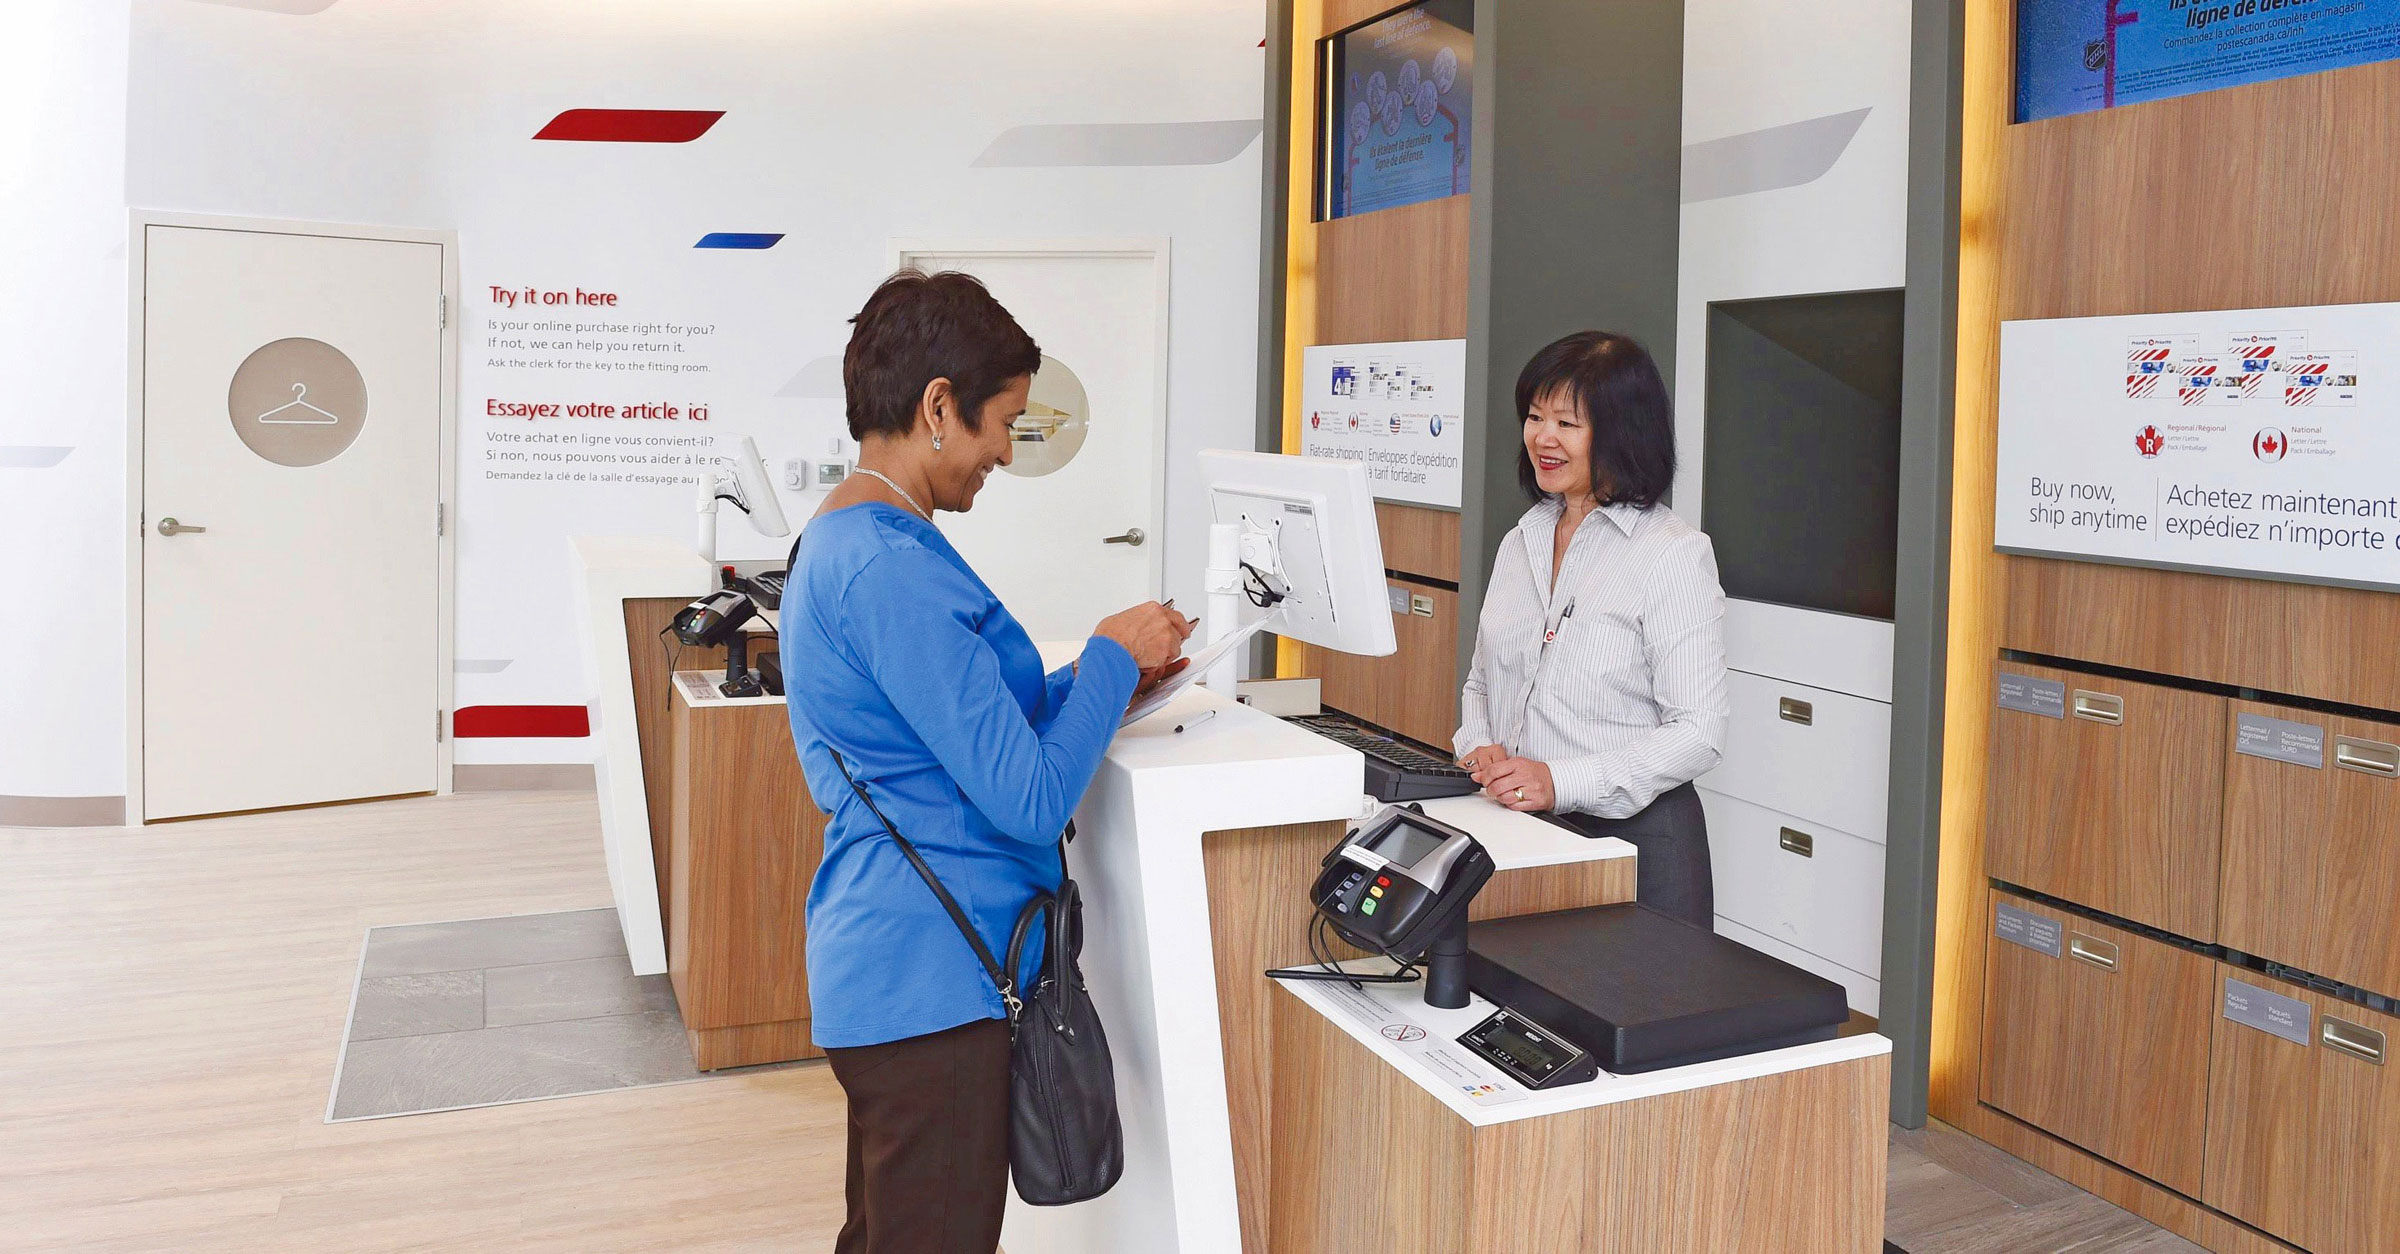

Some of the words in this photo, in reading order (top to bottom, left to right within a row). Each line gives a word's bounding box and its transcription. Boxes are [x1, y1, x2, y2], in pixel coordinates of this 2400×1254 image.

[2186, 5, 2230, 29] ligne
[2234, 0, 2256, 17] de
[2163, 32, 2213, 49] Commandez
[2215, 28, 2223, 39] la
[2225, 20, 2265, 37] collection
[2268, 12, 2308, 28] complète
[2217, 26, 2304, 53] postescanada.ca/lnh
[489, 286, 517, 308] Try
[524, 286, 537, 304] it
[543, 291, 568, 305] on
[576, 287, 617, 306] here
[488, 319, 497, 329] Is
[500, 321, 529, 332] your
[533, 320, 572, 331] online
[576, 322, 629, 334] purchase
[633, 322, 662, 336] right
[666, 323, 683, 334] for
[686, 324, 715, 336] you?
[488, 337, 497, 347] If
[500, 339, 525, 350] not,
[530, 340, 548, 349] we
[552, 340, 573, 350] can
[577, 339, 603, 352] help
[606, 342, 629, 353] you
[632, 342, 669, 352] return
[673, 341, 685, 352] it.
[487, 358, 506, 368] Ask
[509, 358, 527, 368] the
[529, 359, 554, 368] clerk
[557, 359, 572, 369] for
[575, 360, 592, 369] the
[595, 360, 612, 371] key
[615, 362, 625, 371] to
[628, 361, 645, 371] the
[648, 361, 679, 373] fitting
[682, 364, 711, 373] room.
[487, 399, 560, 421] Essayez
[566, 402, 615, 418] votre
[621, 401, 678, 420] article
[688, 402, 708, 420] ici
[2291, 426, 2322, 434] National
[486, 431, 521, 442] Votre
[524, 432, 559, 443] achat
[562, 434, 577, 443] en
[581, 433, 611, 446] ligne
[615, 437, 642, 446] vous
[645, 436, 714, 447] convient-il?
[2146, 439, 2154, 452] R
[486, 449, 497, 460] Si
[500, 451, 528, 462] non,
[532, 452, 562, 462] nous
[565, 453, 617, 464] pouvons
[620, 455, 647, 464] vous
[650, 453, 681, 465] aider
[684, 454, 691, 465] à
[695, 454, 706, 465] le
[1309, 443, 1335, 458] Flat-rate
[1336, 444, 1364, 461] shipping
[1368, 447, 1408, 466] Enveloppes
[1410, 450, 1458, 469] d'expédition
[486, 470, 541, 480] Demandez
[544, 471, 554, 480] la
[556, 471, 571, 481] clé
[573, 472, 586, 481] de
[589, 472, 598, 482] la
[600, 472, 623, 482] salle
[625, 473, 679, 485] d'essayage
[681, 475, 694, 484] au
[1368, 465, 1373, 479] à
[1374, 466, 1389, 480] tarif
[1391, 466, 1426, 484] forfaitaire
[2031, 477, 2063, 503] Buy
[2070, 483, 2115, 505] now,
[2166, 484, 2253, 510] Achetez
[2029, 502, 2065, 530] ship
[2071, 507, 2147, 533] anytime
[2166, 515, 2260, 540] expédiez
[2269, 520, 2385, 551] n'importe
[2240, 723, 2267, 734] Lettermail
[2240, 730, 2268, 742] Registered
[2281, 731, 2316, 744] Poste-lettres
[2227, 992, 2248, 1005] Packets
[2268, 1006, 2291, 1019] Paquets
